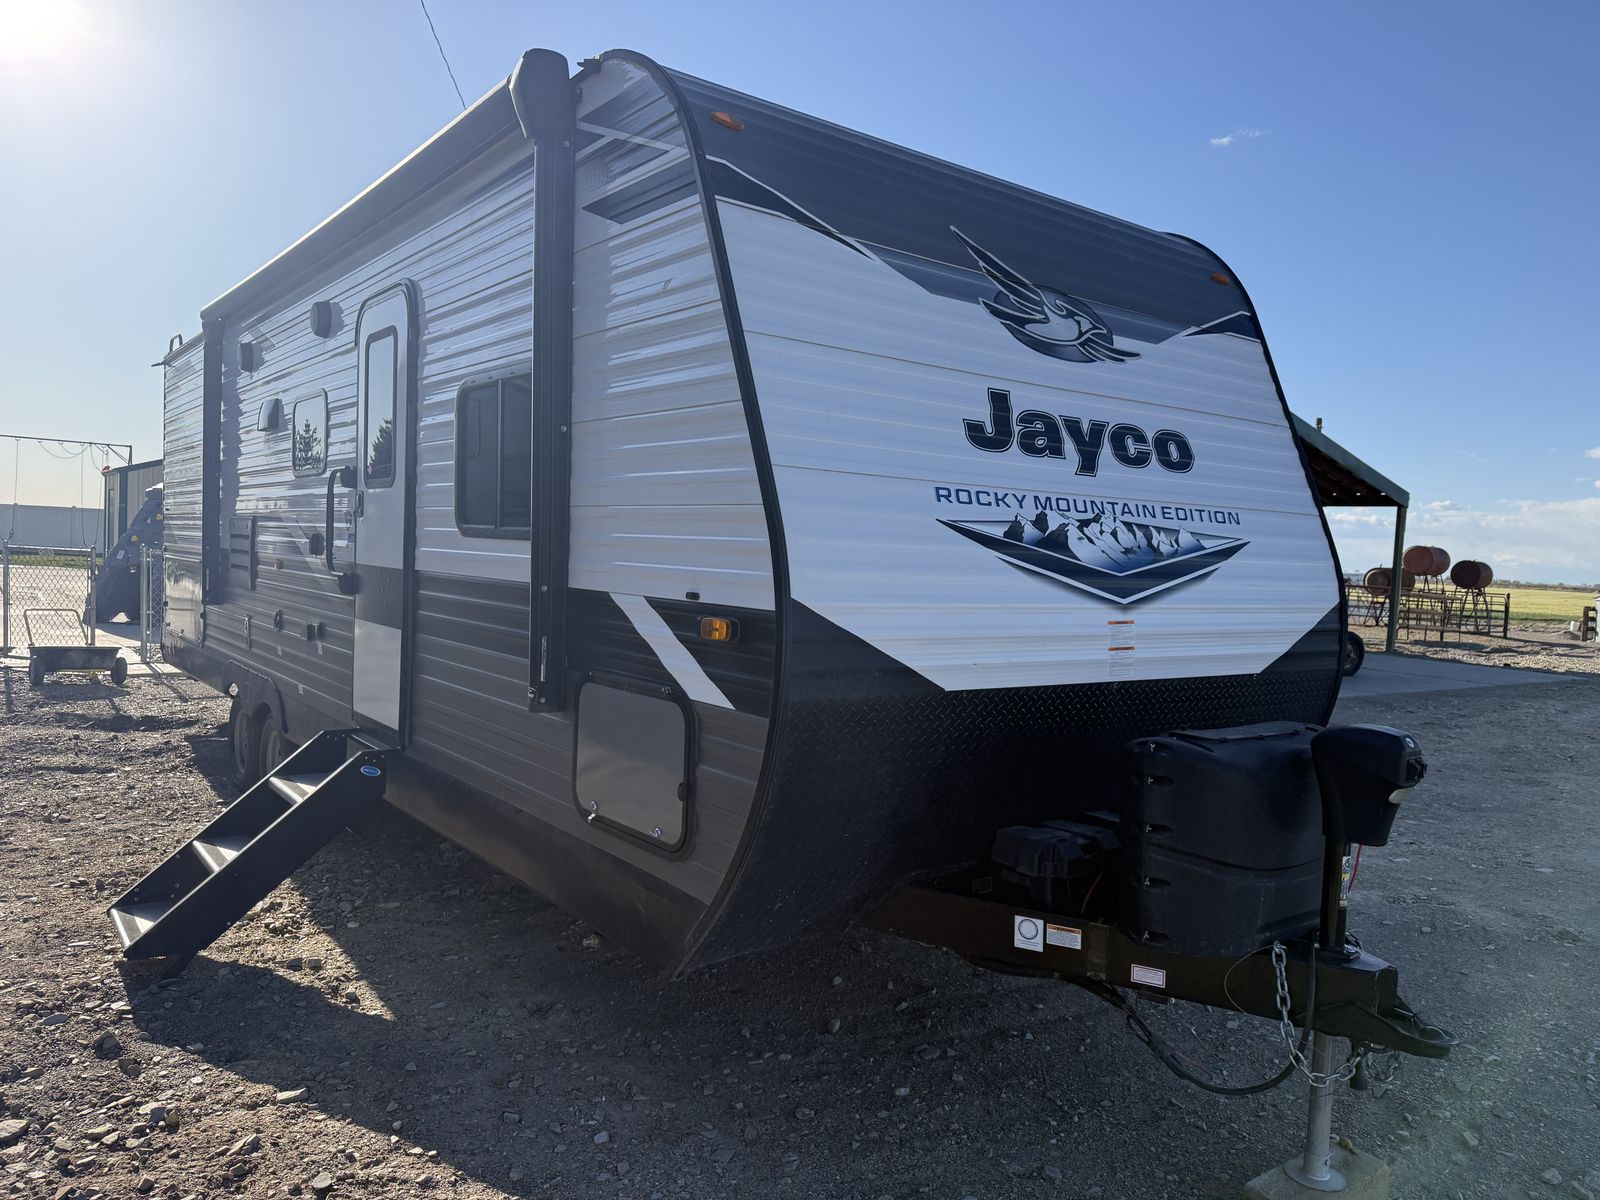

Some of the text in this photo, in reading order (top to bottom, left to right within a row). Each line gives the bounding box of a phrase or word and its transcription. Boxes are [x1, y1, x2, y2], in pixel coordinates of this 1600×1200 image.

[962, 387, 1195, 477] Jayco
[934, 486, 1241, 526] ROCKY MOUNTAIN EDITION
